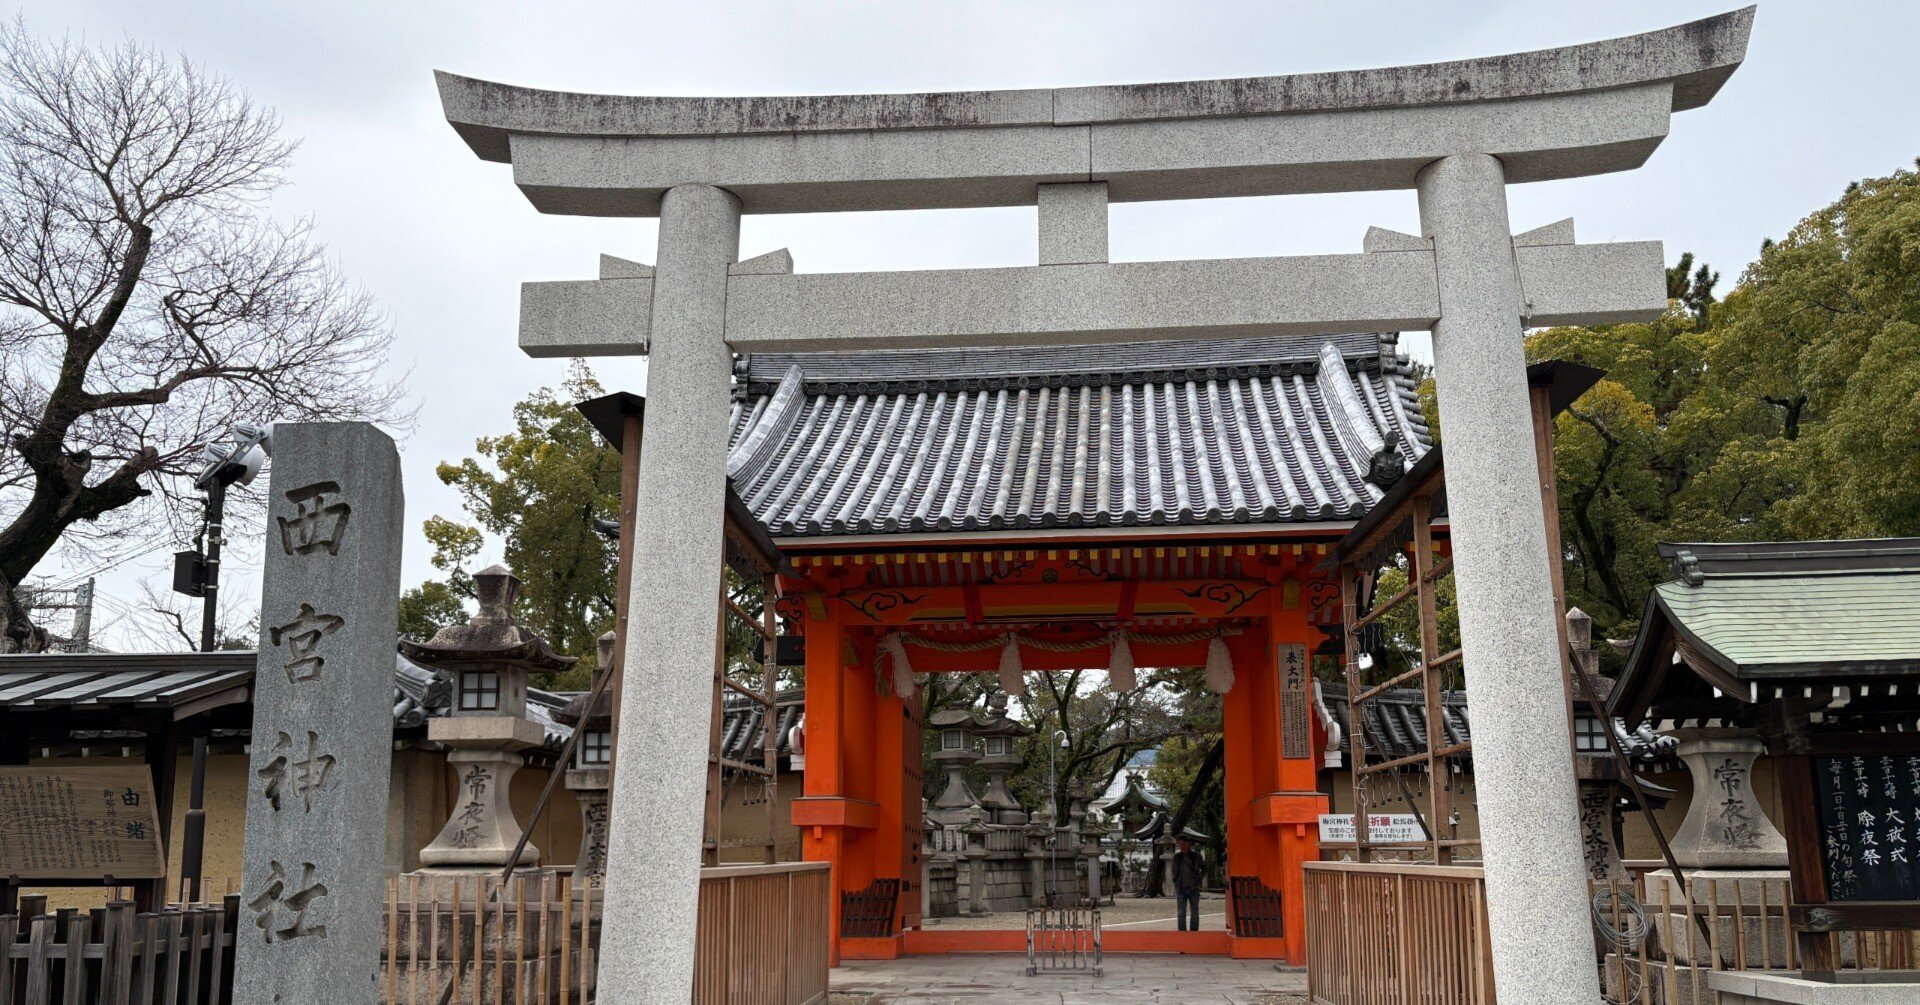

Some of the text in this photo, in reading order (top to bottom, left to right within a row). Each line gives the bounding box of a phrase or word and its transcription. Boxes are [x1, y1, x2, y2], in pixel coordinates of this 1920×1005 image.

[1286, 651, 1298, 690] 表大門
[248, 480, 351, 944] 西宮神社
[121, 787, 145, 840] 由緒
[1350, 816, 1391, 826] 安祈願
[1857, 810, 1881, 866] 除夜祭
[1885, 807, 1908, 863] 大祓式
